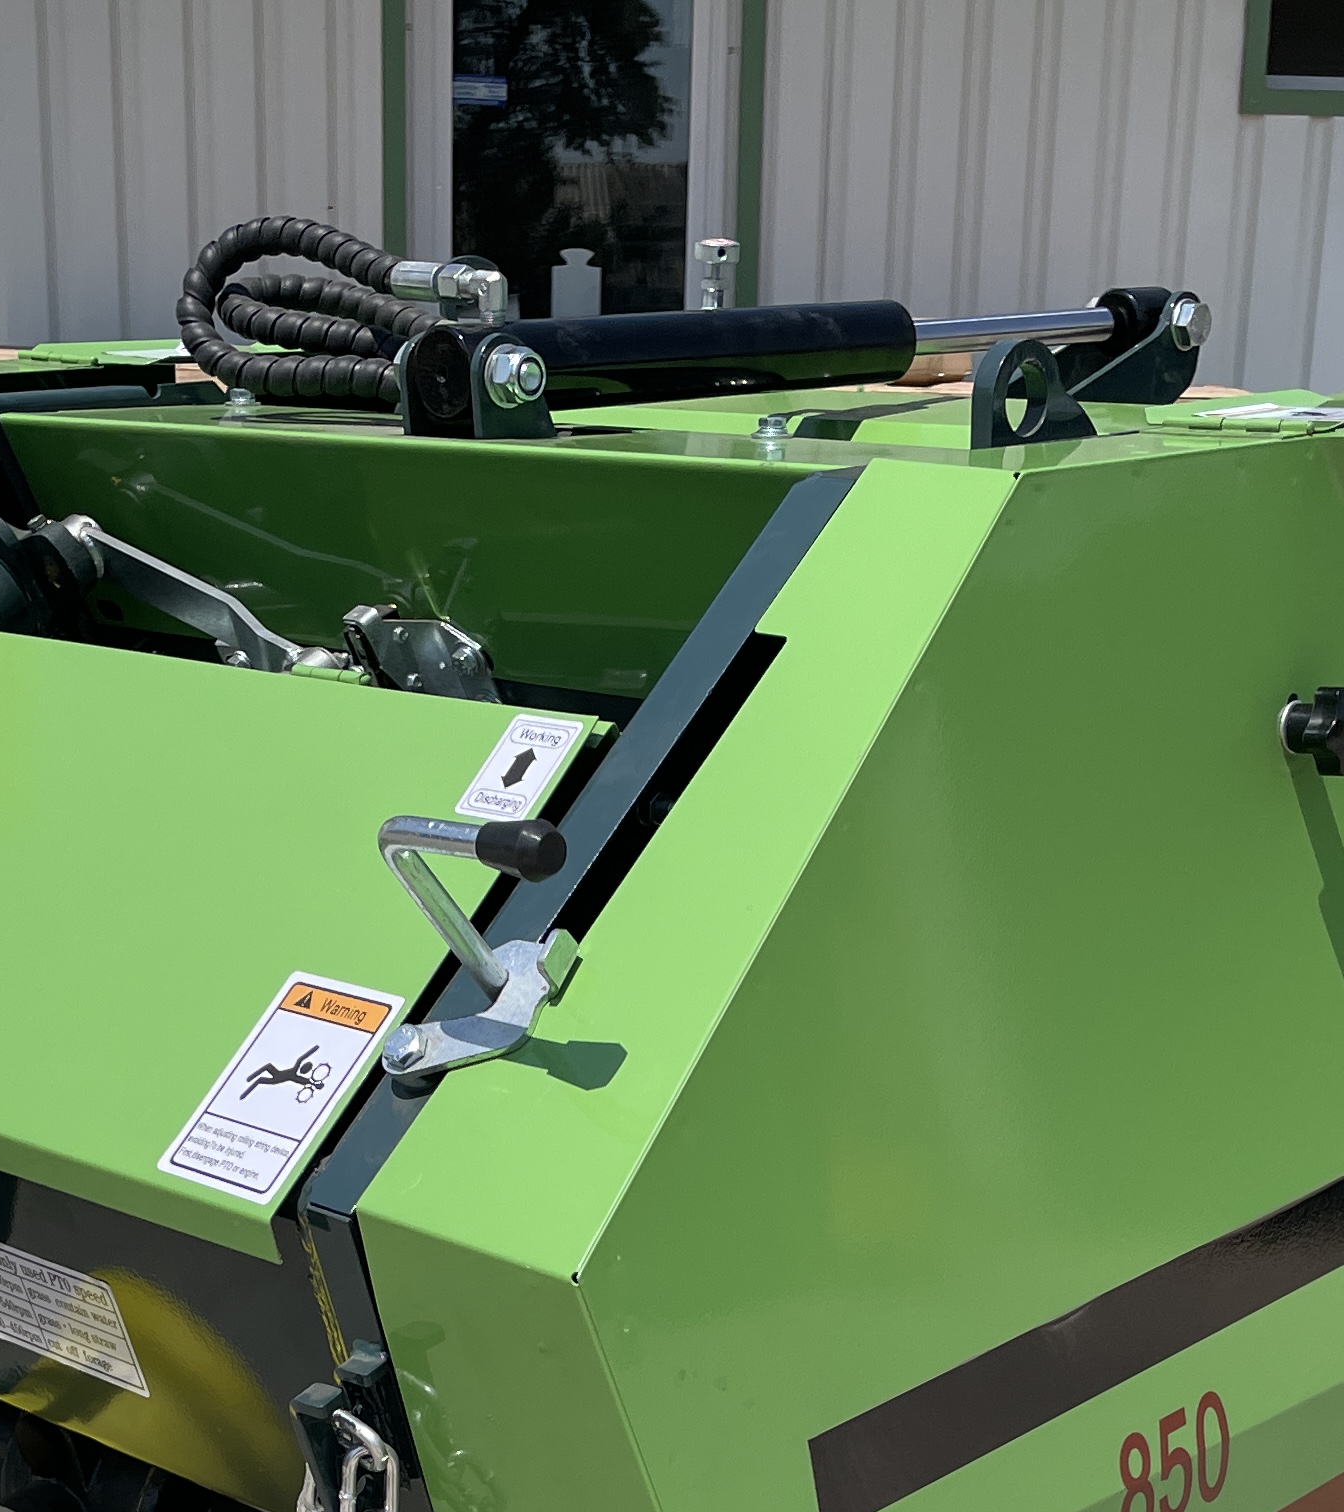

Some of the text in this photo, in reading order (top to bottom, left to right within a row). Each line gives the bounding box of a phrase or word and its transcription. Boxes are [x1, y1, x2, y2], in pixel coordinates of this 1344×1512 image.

[519, 727, 562, 747] Working
[474, 791, 522, 813] Discharging
[321, 999, 366, 1025] Warning
[19, 1265, 47, 1283] used
[73, 1284, 108, 1305] speed
[55, 1298, 89, 1318] contain
[90, 1312, 117, 1329] water
